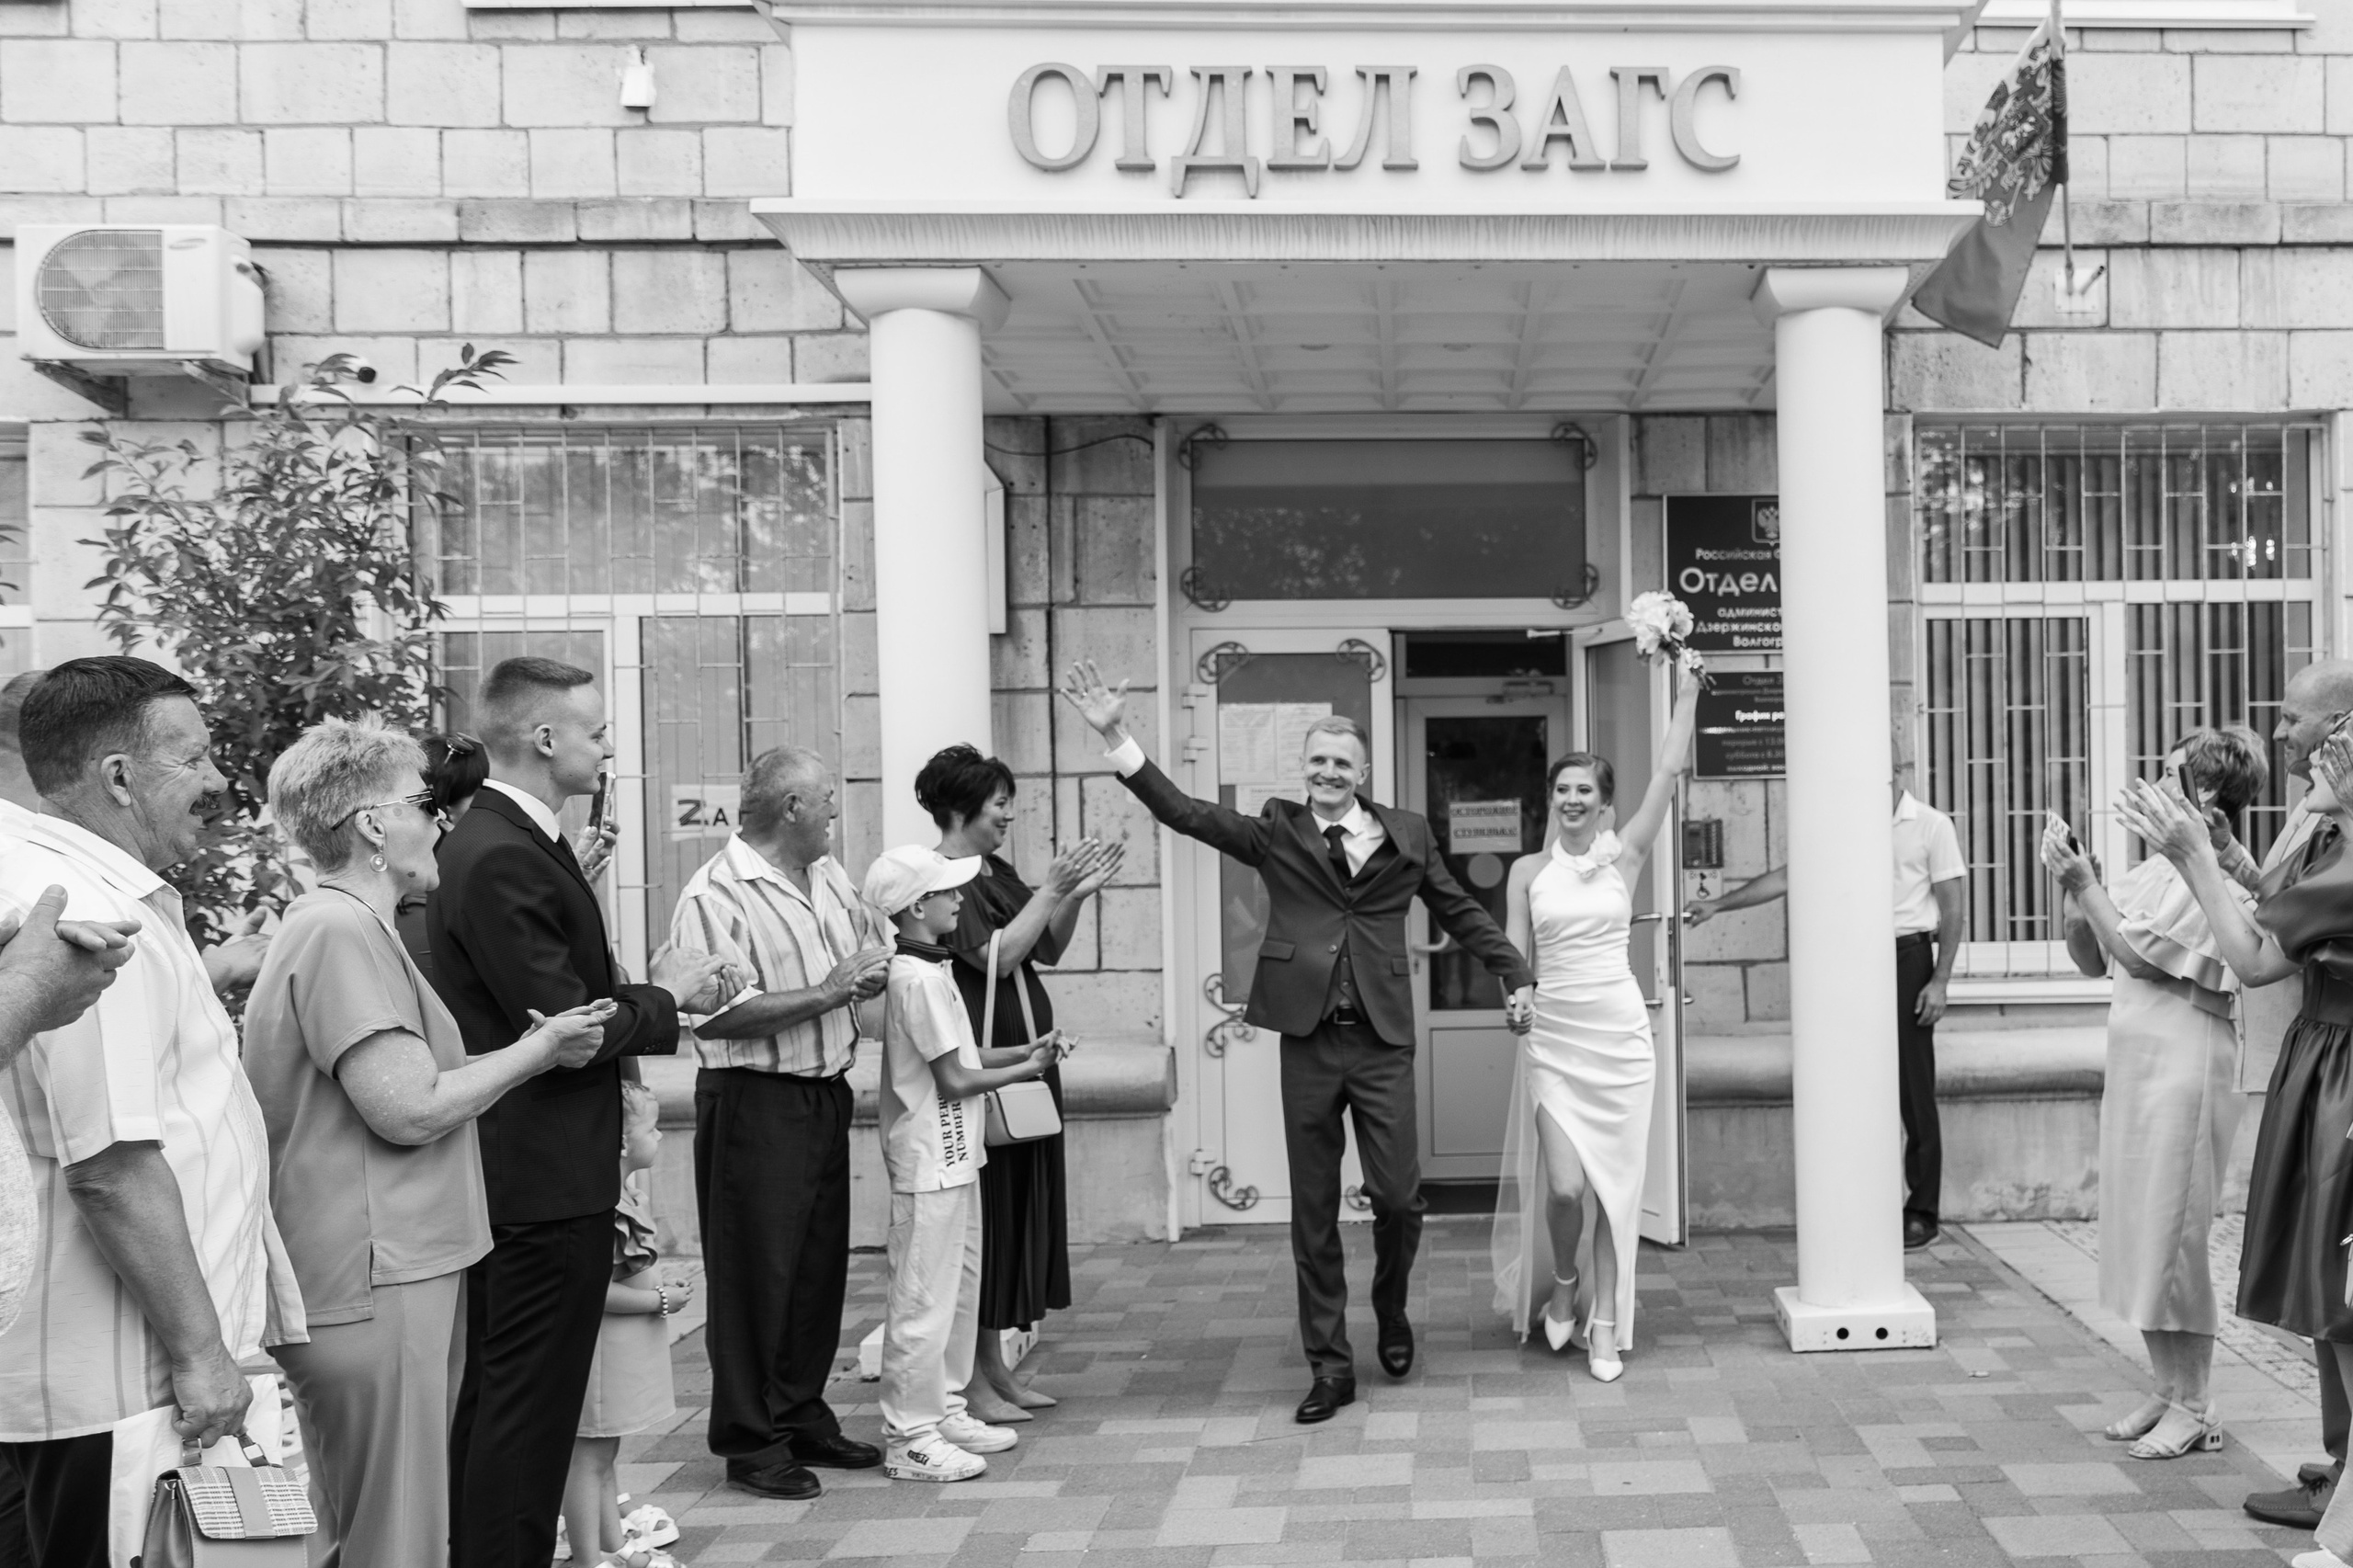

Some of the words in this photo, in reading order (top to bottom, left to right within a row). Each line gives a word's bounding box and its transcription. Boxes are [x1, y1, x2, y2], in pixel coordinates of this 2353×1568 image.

[1006, 61, 1420, 199] ОТДЕЛ
[1456, 63, 1743, 174] ЗАГС
[1695, 548, 1772, 561] Российская
[1678, 566, 1779, 597] Отдел
[1695, 620, 1782, 634] Дзержинско
[1735, 710, 1771, 722] График
[951, 1101, 969, 1162] NUMBER
[942, 1130, 956, 1168] YOUR
